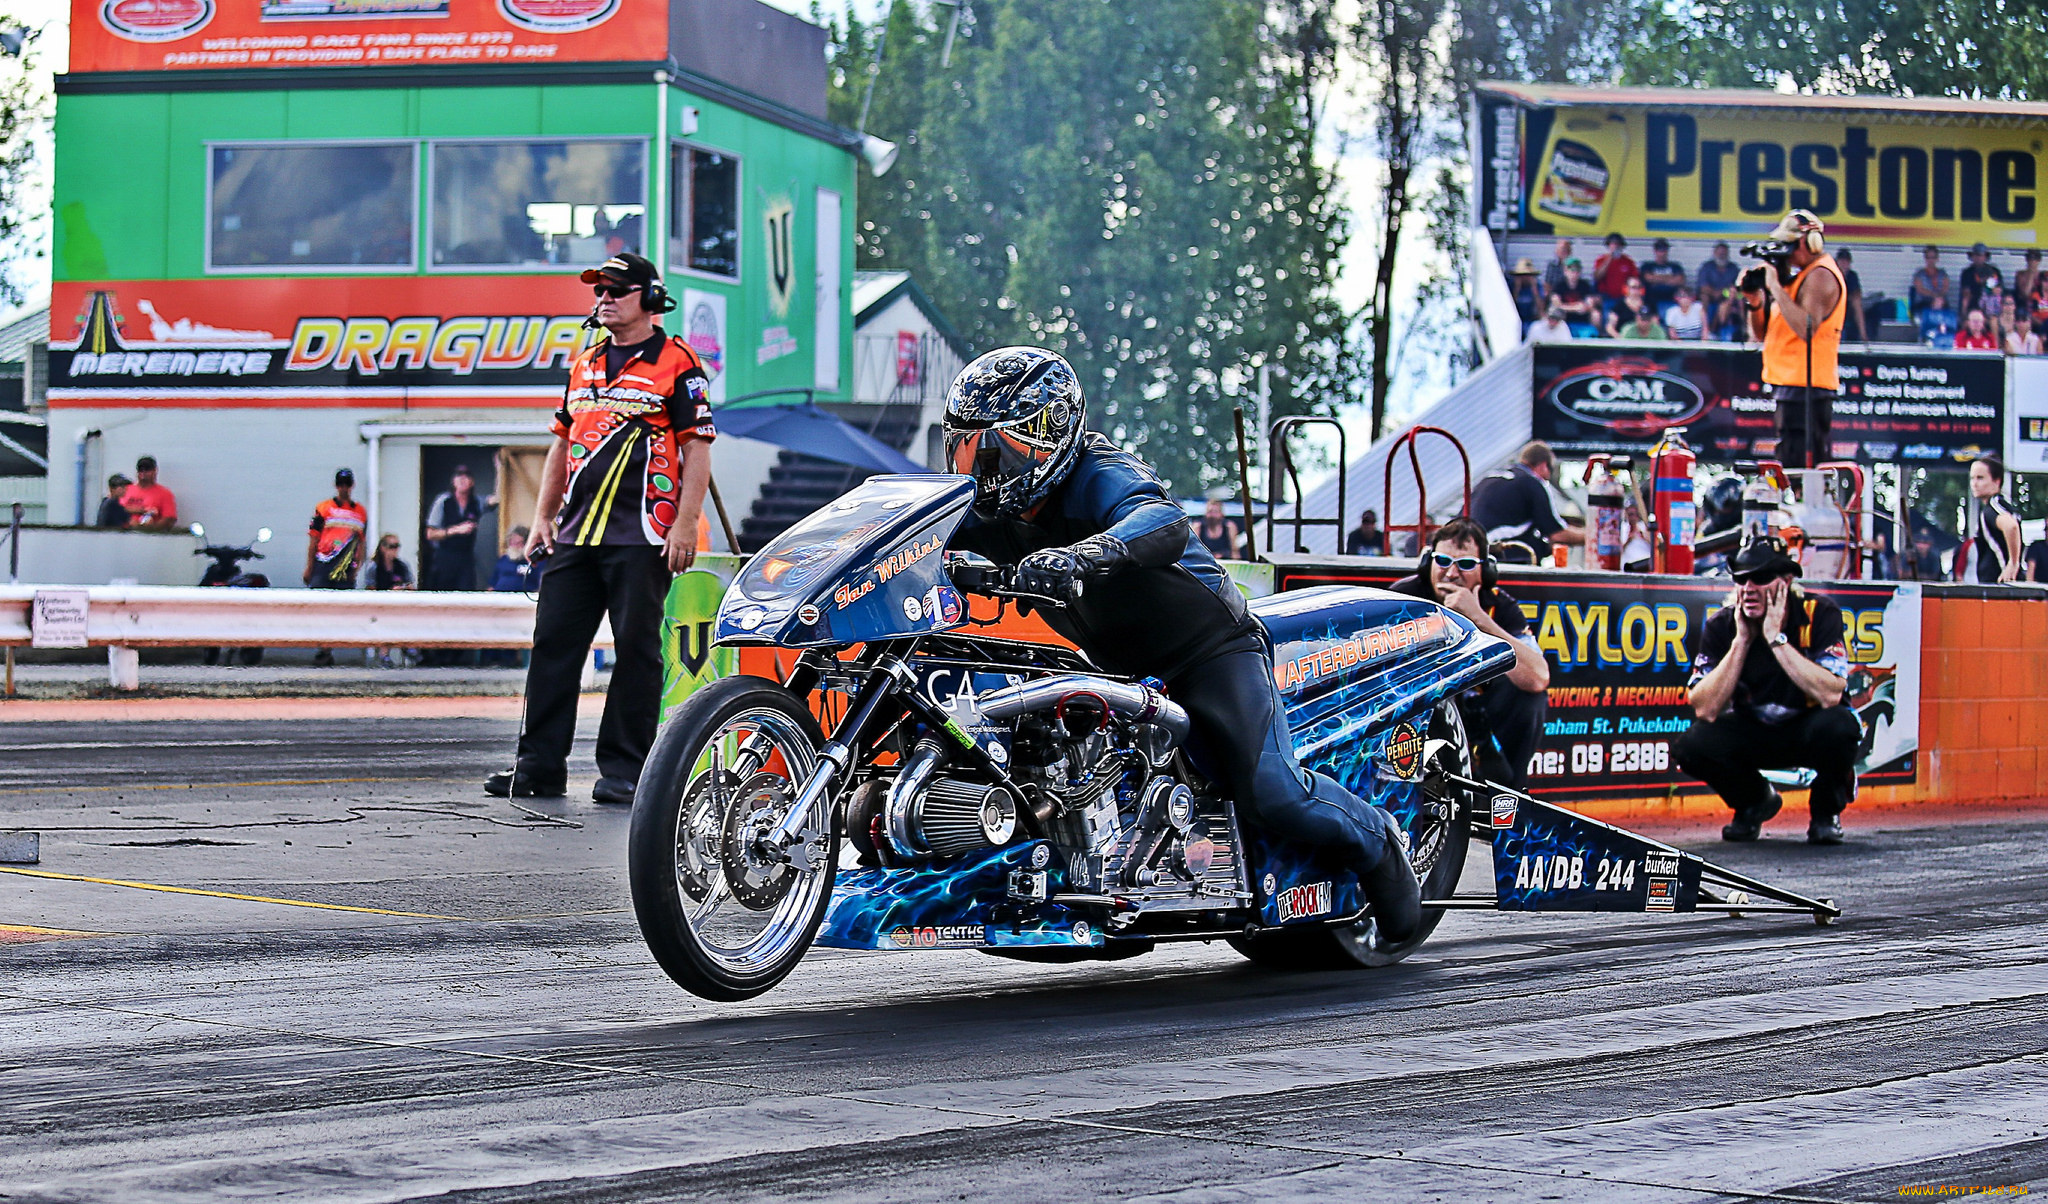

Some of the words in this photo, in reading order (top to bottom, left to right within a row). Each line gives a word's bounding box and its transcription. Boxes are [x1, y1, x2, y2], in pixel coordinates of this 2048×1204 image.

[202, 35, 308, 50] WELCOMING
[311, 34, 361, 48] RACE
[363, 33, 411, 46] FANS
[414, 32, 468, 46] SINCE
[164, 51, 250, 66] PARTNERS
[250, 50, 271, 62] IN
[273, 48, 364, 62] PROVIDING
[366, 47, 381, 60] A
[383, 46, 426, 60] SAFE
[428, 45, 482, 59] PLACE
[485, 44, 510, 58] TO
[511, 44, 558, 58] RACE
[1488, 107, 1520, 230] Prestone
[1645, 111, 2037, 223] Prestone
[69, 351, 272, 378] MEREMERE
[1863, 381, 1902, 398] Speed
[1903, 383, 1965, 400] Equipment
[1892, 401, 1948, 417] American
[1948, 403, 1996, 419] Vehicles
[872, 533, 944, 584] Wilkins
[1285, 620, 1420, 689] AFTERBURNER
[927, 669, 979, 716] G4
[1547, 686, 1600, 708] RVICING
[1615, 686, 1692, 706] MECHANICA
[1543, 717, 1588, 736] raham
[1592, 716, 1614, 735] St.
[1386, 736, 1423, 762] PENRITE
[1571, 743, 1604, 774] 09
[1610, 741, 1670, 773] 2386
[1514, 854, 1584, 893] AA/DB
[1595, 857, 1636, 892] 244
[1644, 855, 1679, 876] burkert
[935, 926, 985, 940] TENTHS
